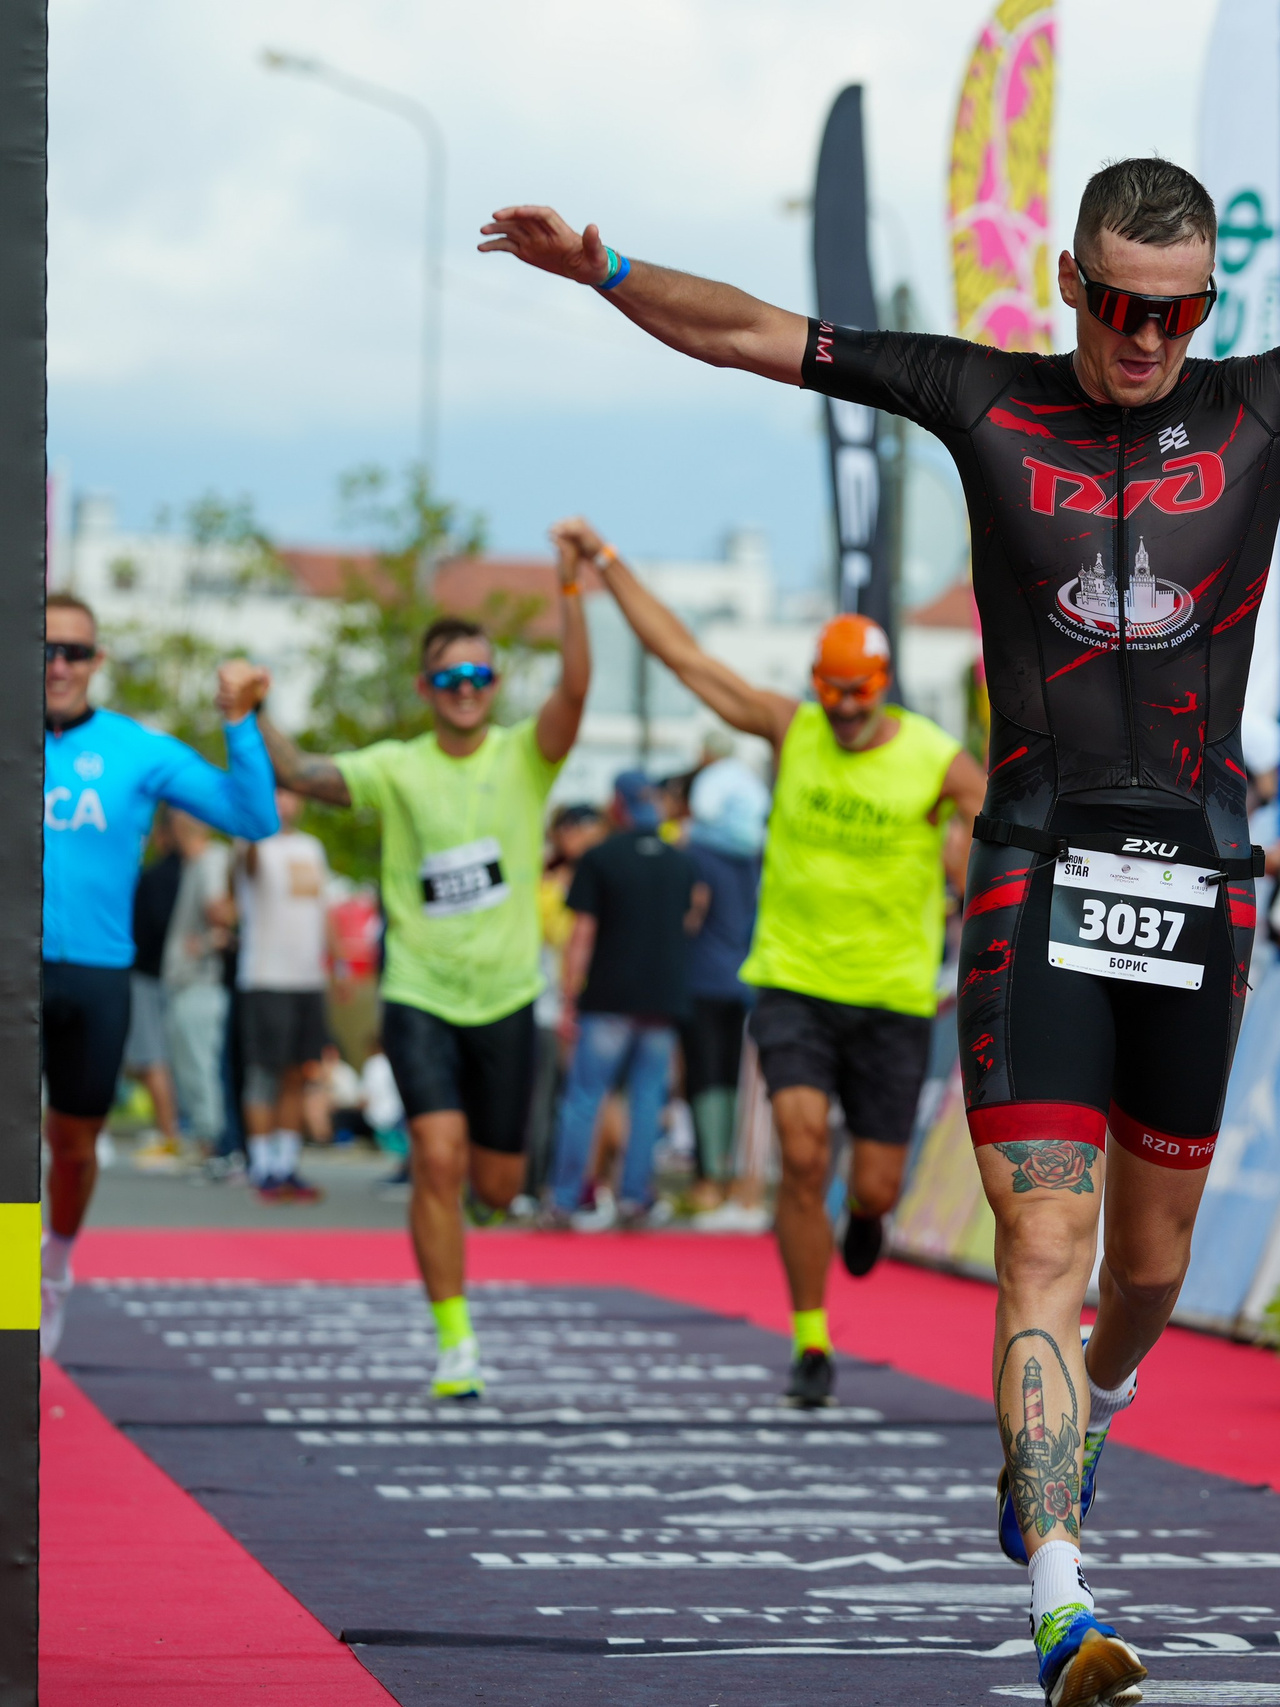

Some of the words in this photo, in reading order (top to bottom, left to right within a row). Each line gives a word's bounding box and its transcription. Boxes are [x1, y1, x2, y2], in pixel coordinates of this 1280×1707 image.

[1047, 612, 1108, 649] МОСКОВСКАЯ
[1110, 641, 1169, 651] ЖЕЛЕЗНАЯ
[1170, 622, 1201, 648] ДОРОГА
[1121, 838, 1180, 858] 2XU
[1068, 854, 1084, 865] RON
[1064, 863, 1090, 878] STAR
[1078, 898, 1186, 952] 3037
[1109, 957, 1149, 973] БОРИС
[1142, 1133, 1180, 1156] RZD
[1187, 1140, 1217, 1157] Tria
